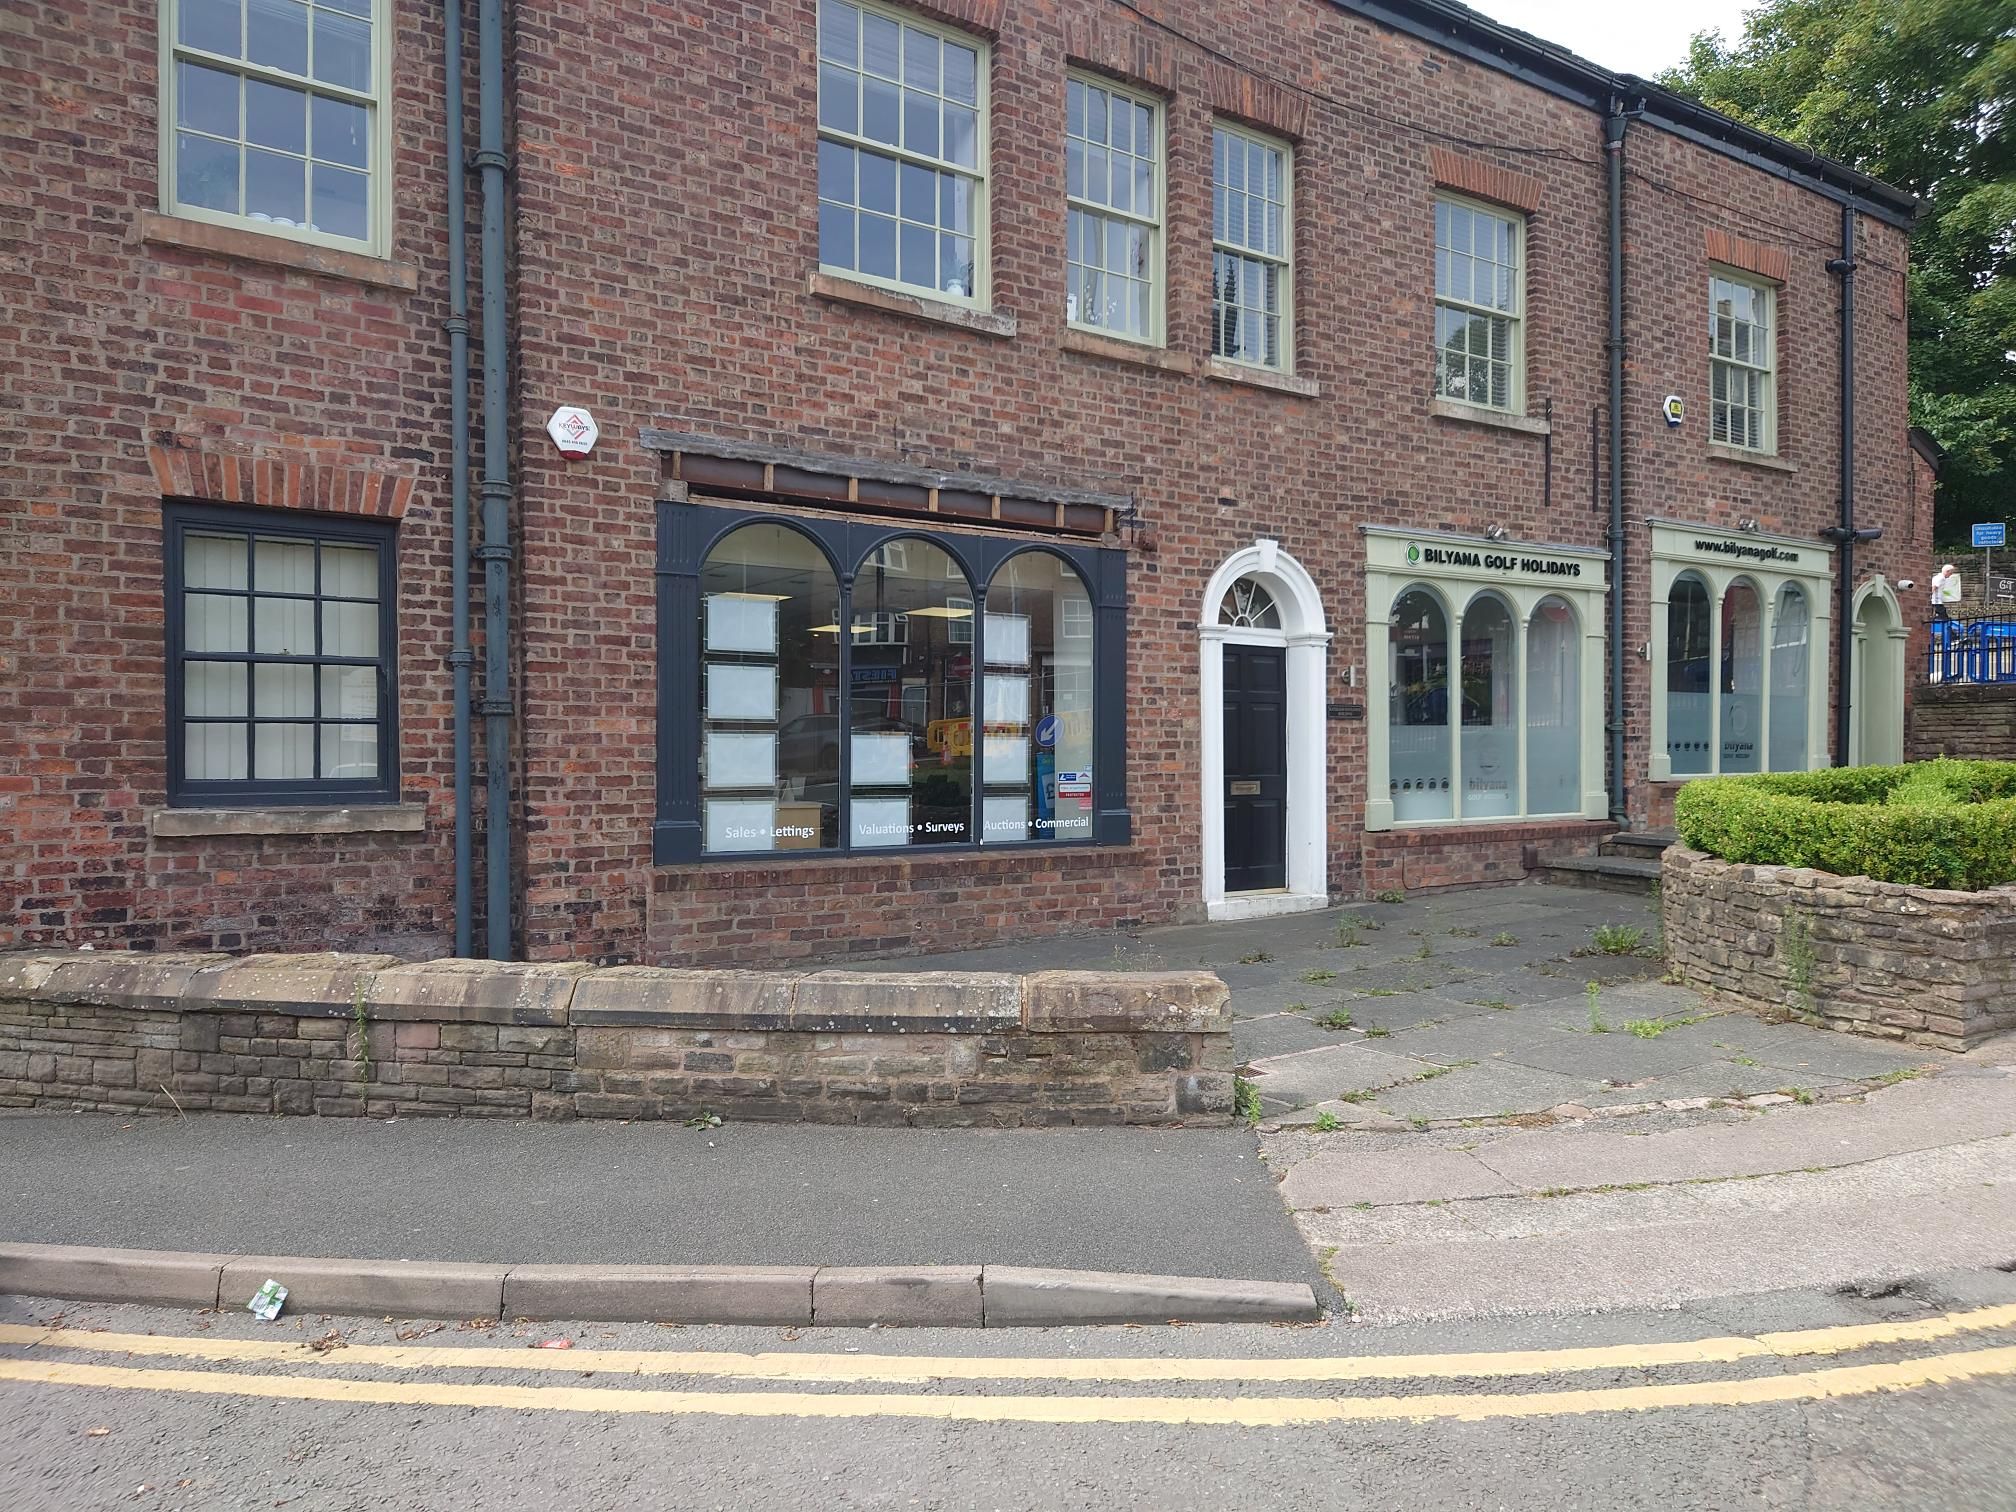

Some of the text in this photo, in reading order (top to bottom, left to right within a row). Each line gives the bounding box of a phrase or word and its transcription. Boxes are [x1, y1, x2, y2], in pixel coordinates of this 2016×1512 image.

[1695, 540, 1799, 561] www.bilyanagolf.com
[1424, 548, 1581, 577] BILYANA GOLF HOLIDAYS
[859, 821, 965, 835] Valuations Surveys
[984, 816, 1089, 831] Auctions Commercial
[725, 825, 815, 839] Sales Lettings
